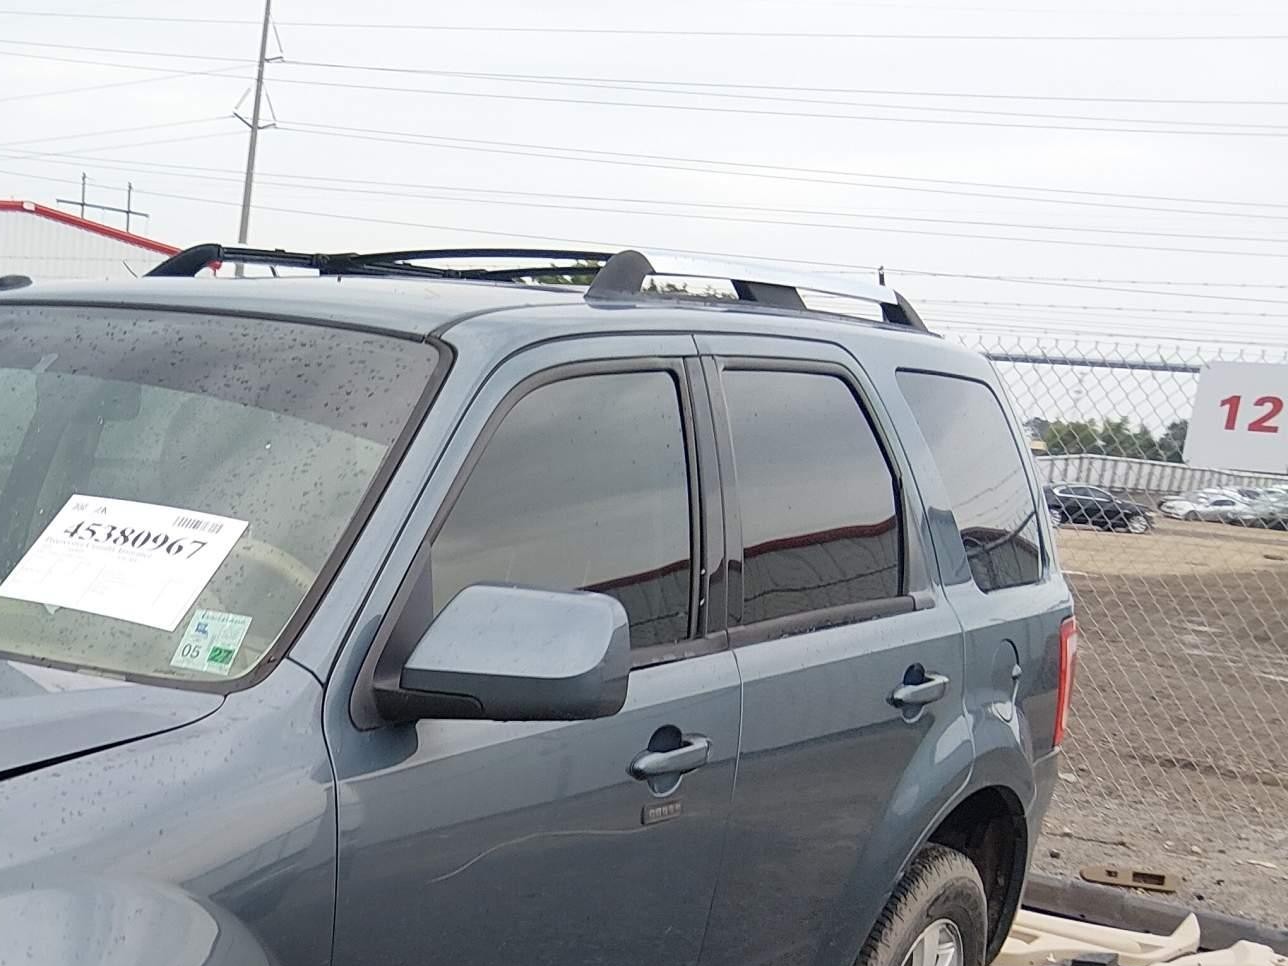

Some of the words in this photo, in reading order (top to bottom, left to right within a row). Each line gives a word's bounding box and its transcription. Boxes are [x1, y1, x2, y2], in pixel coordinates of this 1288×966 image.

[1220, 395, 1284, 434] 12
[63, 519, 208, 560] 45380967
[181, 643, 204, 660] 05
